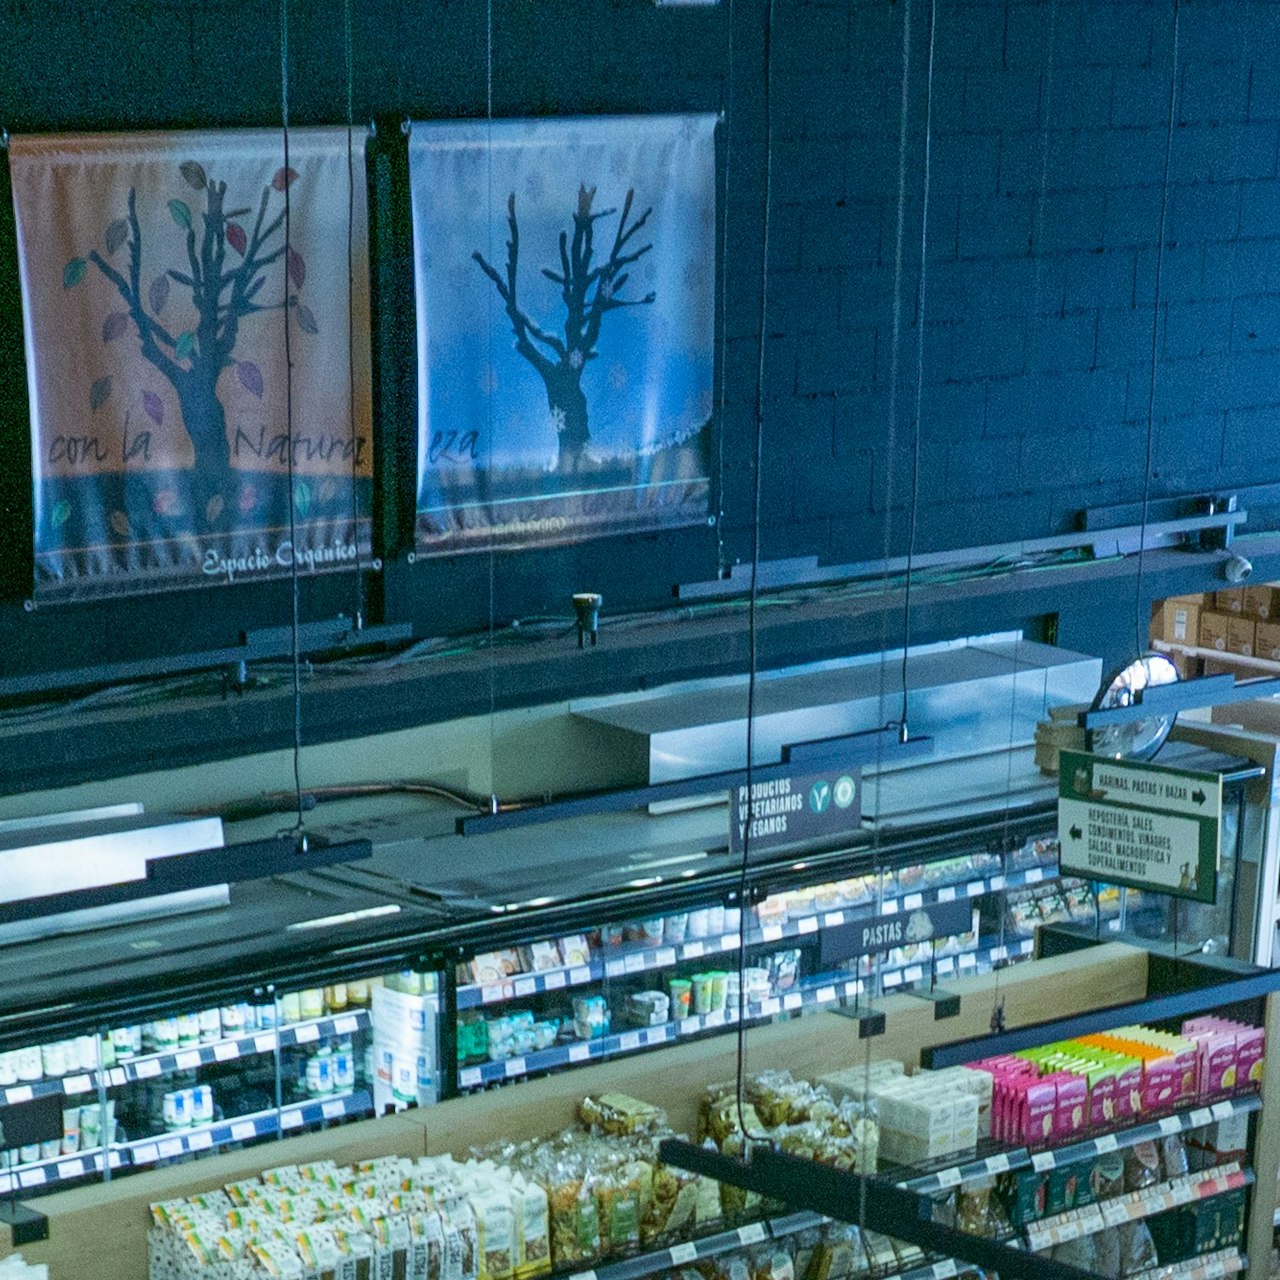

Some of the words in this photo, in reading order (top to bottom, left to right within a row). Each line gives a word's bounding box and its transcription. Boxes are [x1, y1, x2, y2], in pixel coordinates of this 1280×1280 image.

[48, 433, 107, 464] con
[121, 411, 152, 464] la
[202, 547, 270, 581] Espacio
[275, 539, 358, 571] Orgánico
[1132, 780, 1158, 799] PASTAS
[1165, 785, 1188, 800] BAZAR
[739, 823, 746, 840] Y
[1088, 853, 1147, 876] SUPERALIMENTOS
[862, 921, 902, 947] PASTAS
